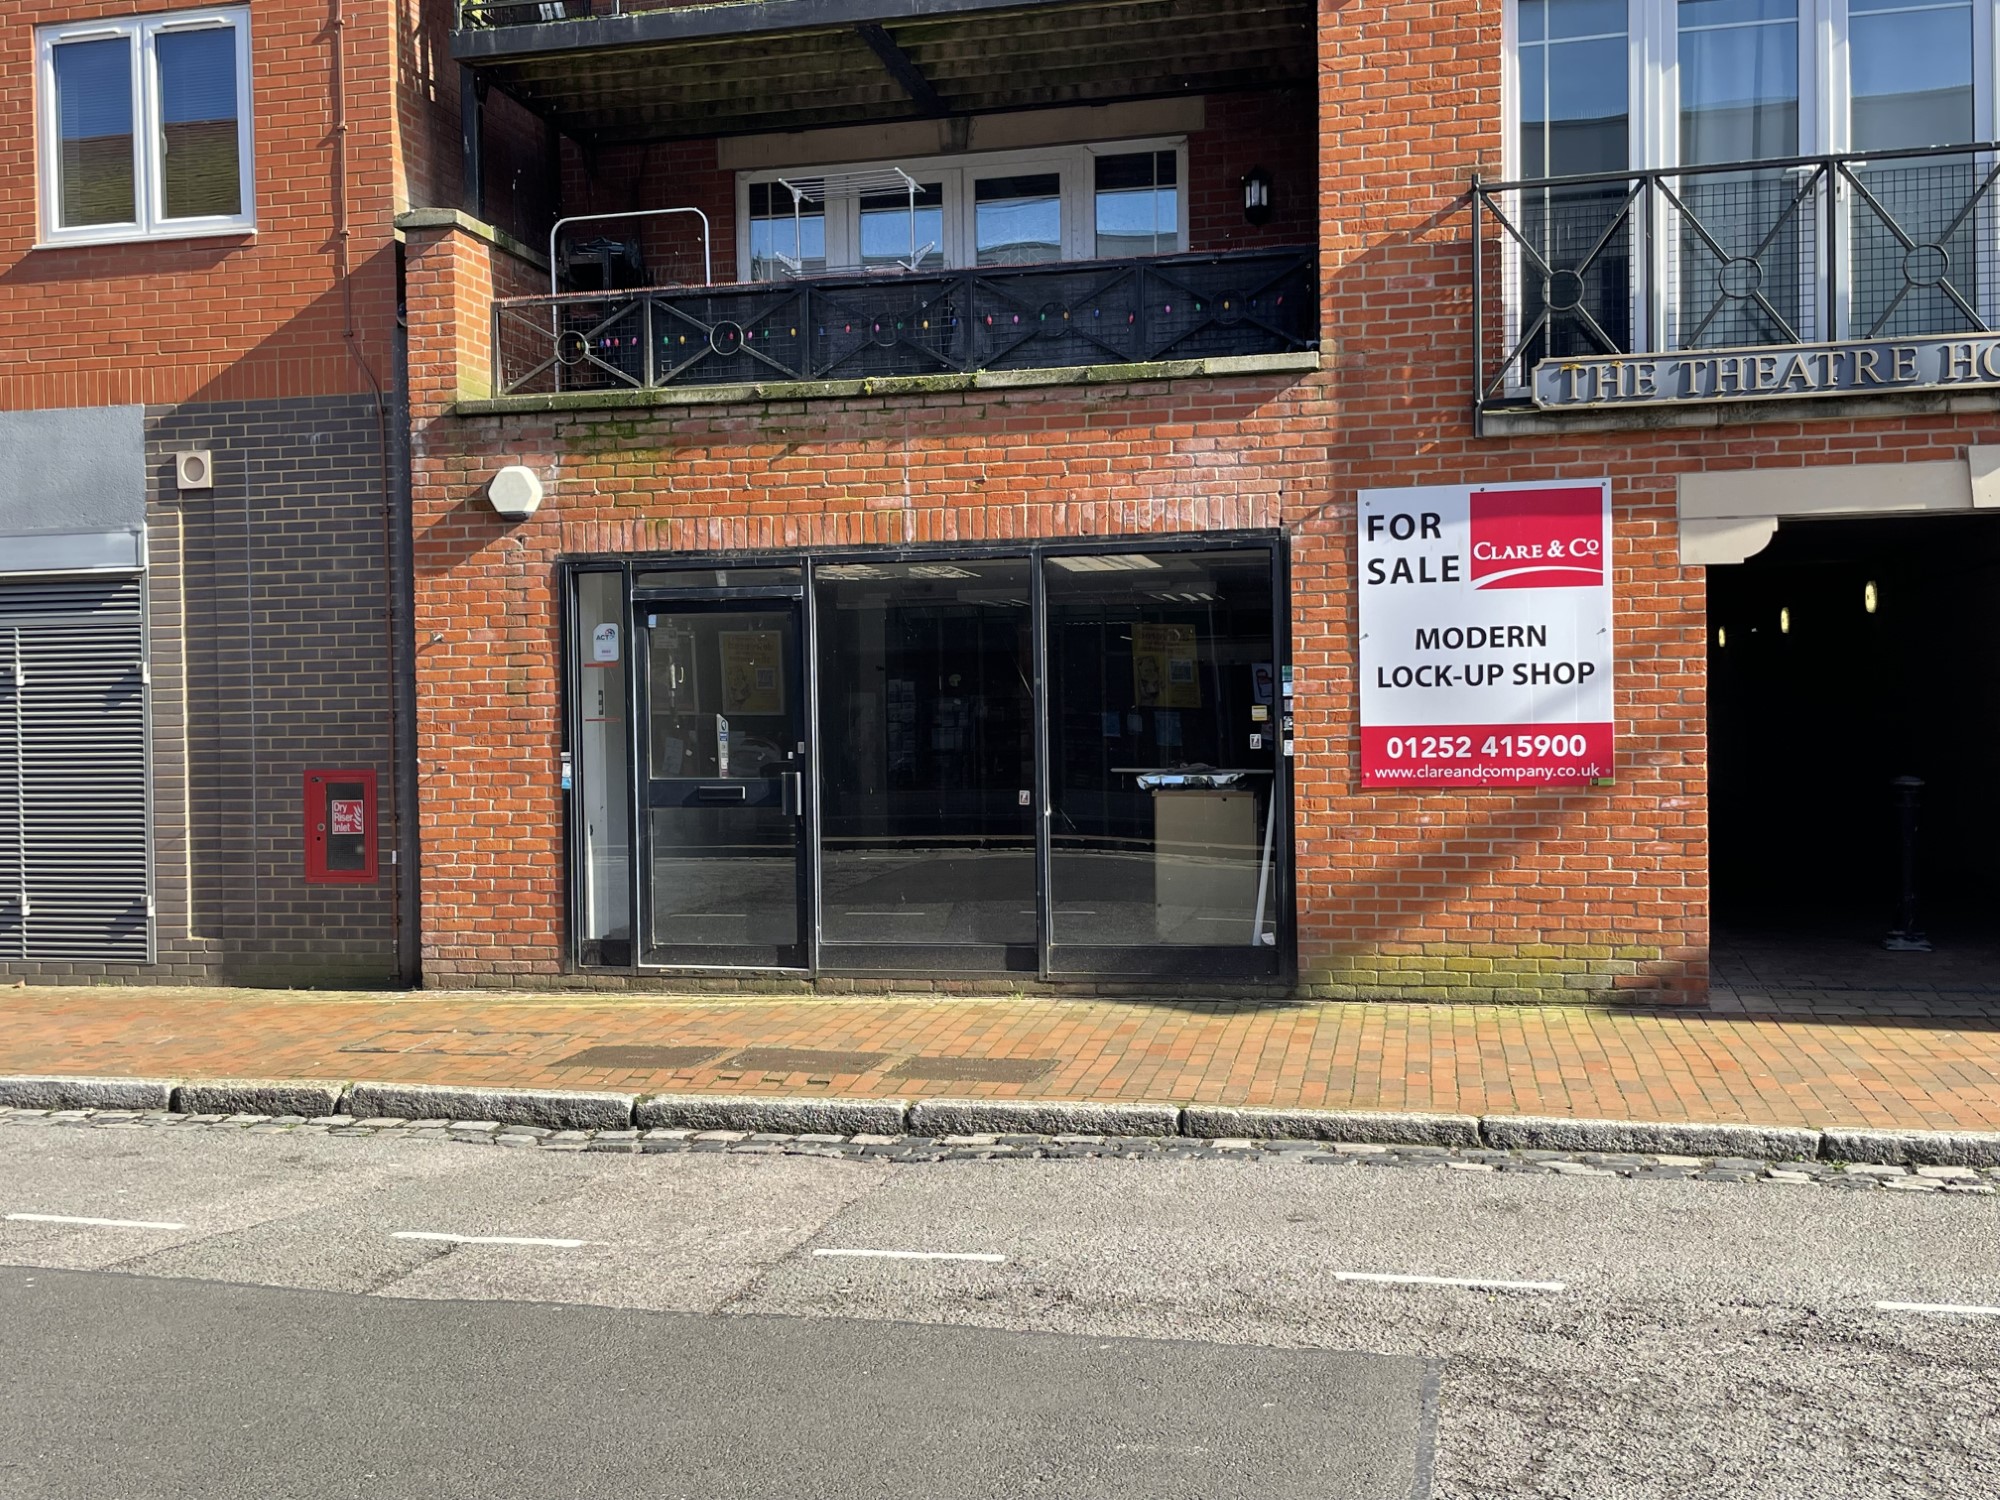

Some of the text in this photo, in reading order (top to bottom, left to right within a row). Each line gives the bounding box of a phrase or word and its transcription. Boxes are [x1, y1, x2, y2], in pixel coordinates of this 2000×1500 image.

[1562, 362, 1658, 401] THE
[1680, 348, 1919, 394] THEATRE
[1367, 512, 1442, 542] FOR
[1473, 541, 1543, 561] CLARE
[1547, 539, 1566, 558] &
[1367, 555, 1461, 585] SALE
[1415, 624, 1547, 650] MODERN
[1377, 661, 1595, 688] LOCK-UP SHOP
[1386, 734, 1587, 759] 01252 415900
[1374, 762, 1600, 782] www.clareandcompany.co.uk
[333, 802, 347, 813] Dry
[334, 813, 353, 821] Riser
[334, 822, 350, 831] Inlet
